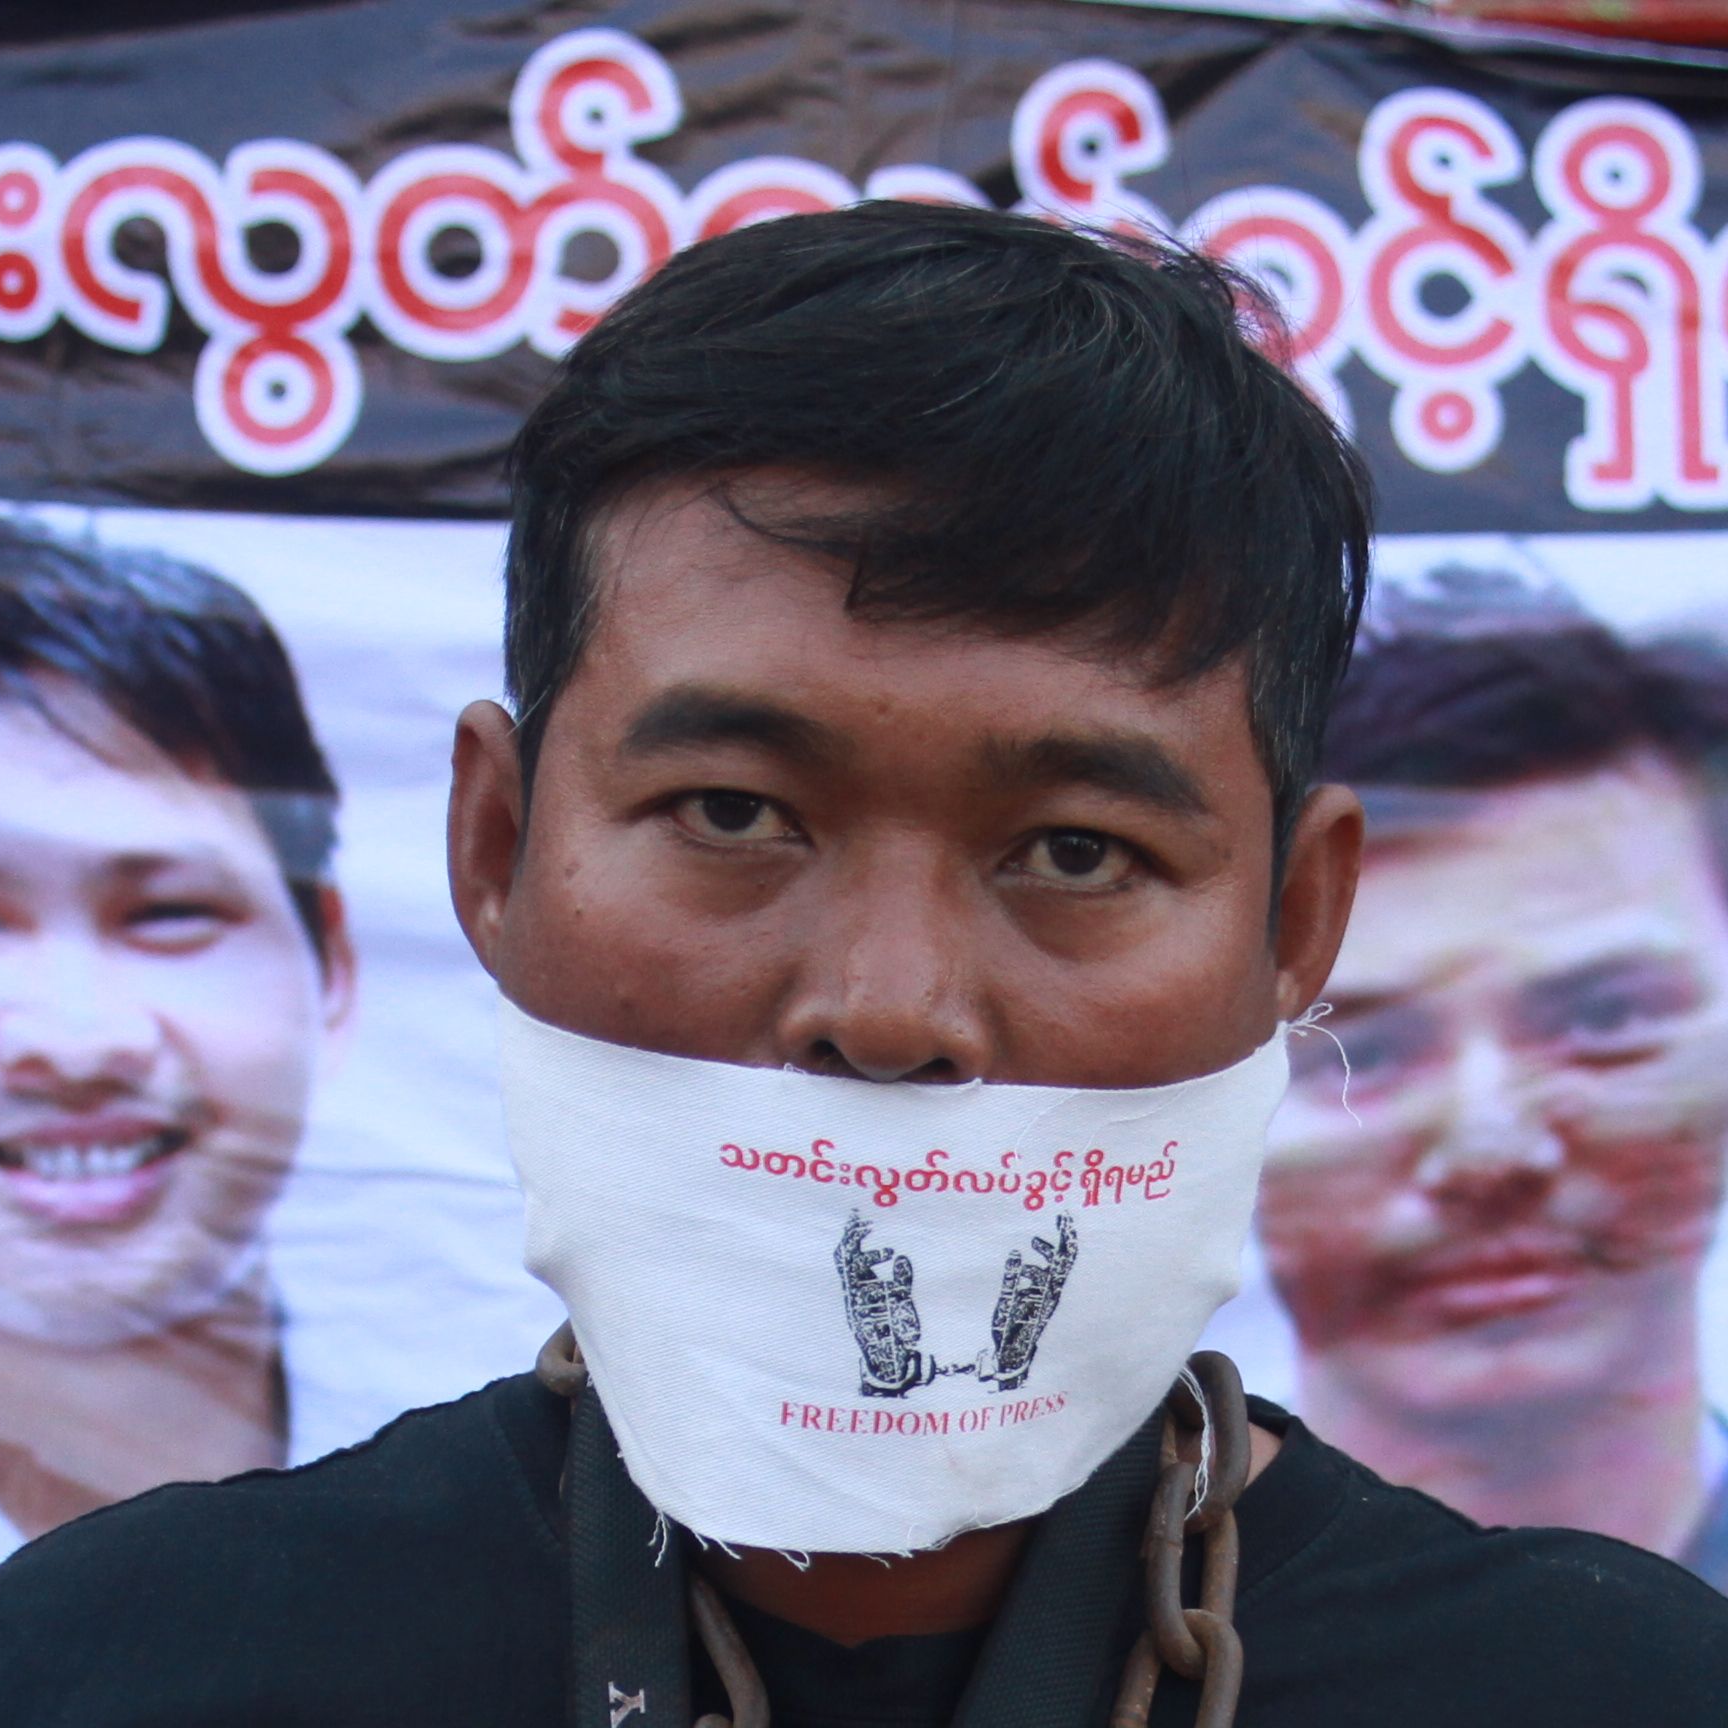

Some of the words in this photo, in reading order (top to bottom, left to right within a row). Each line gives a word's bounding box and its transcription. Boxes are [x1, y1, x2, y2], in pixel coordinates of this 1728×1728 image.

[780, 1400, 949, 1436] FREEDOM
[958, 1405, 995, 1433] OF
[999, 1390, 1069, 1428] PRESS
